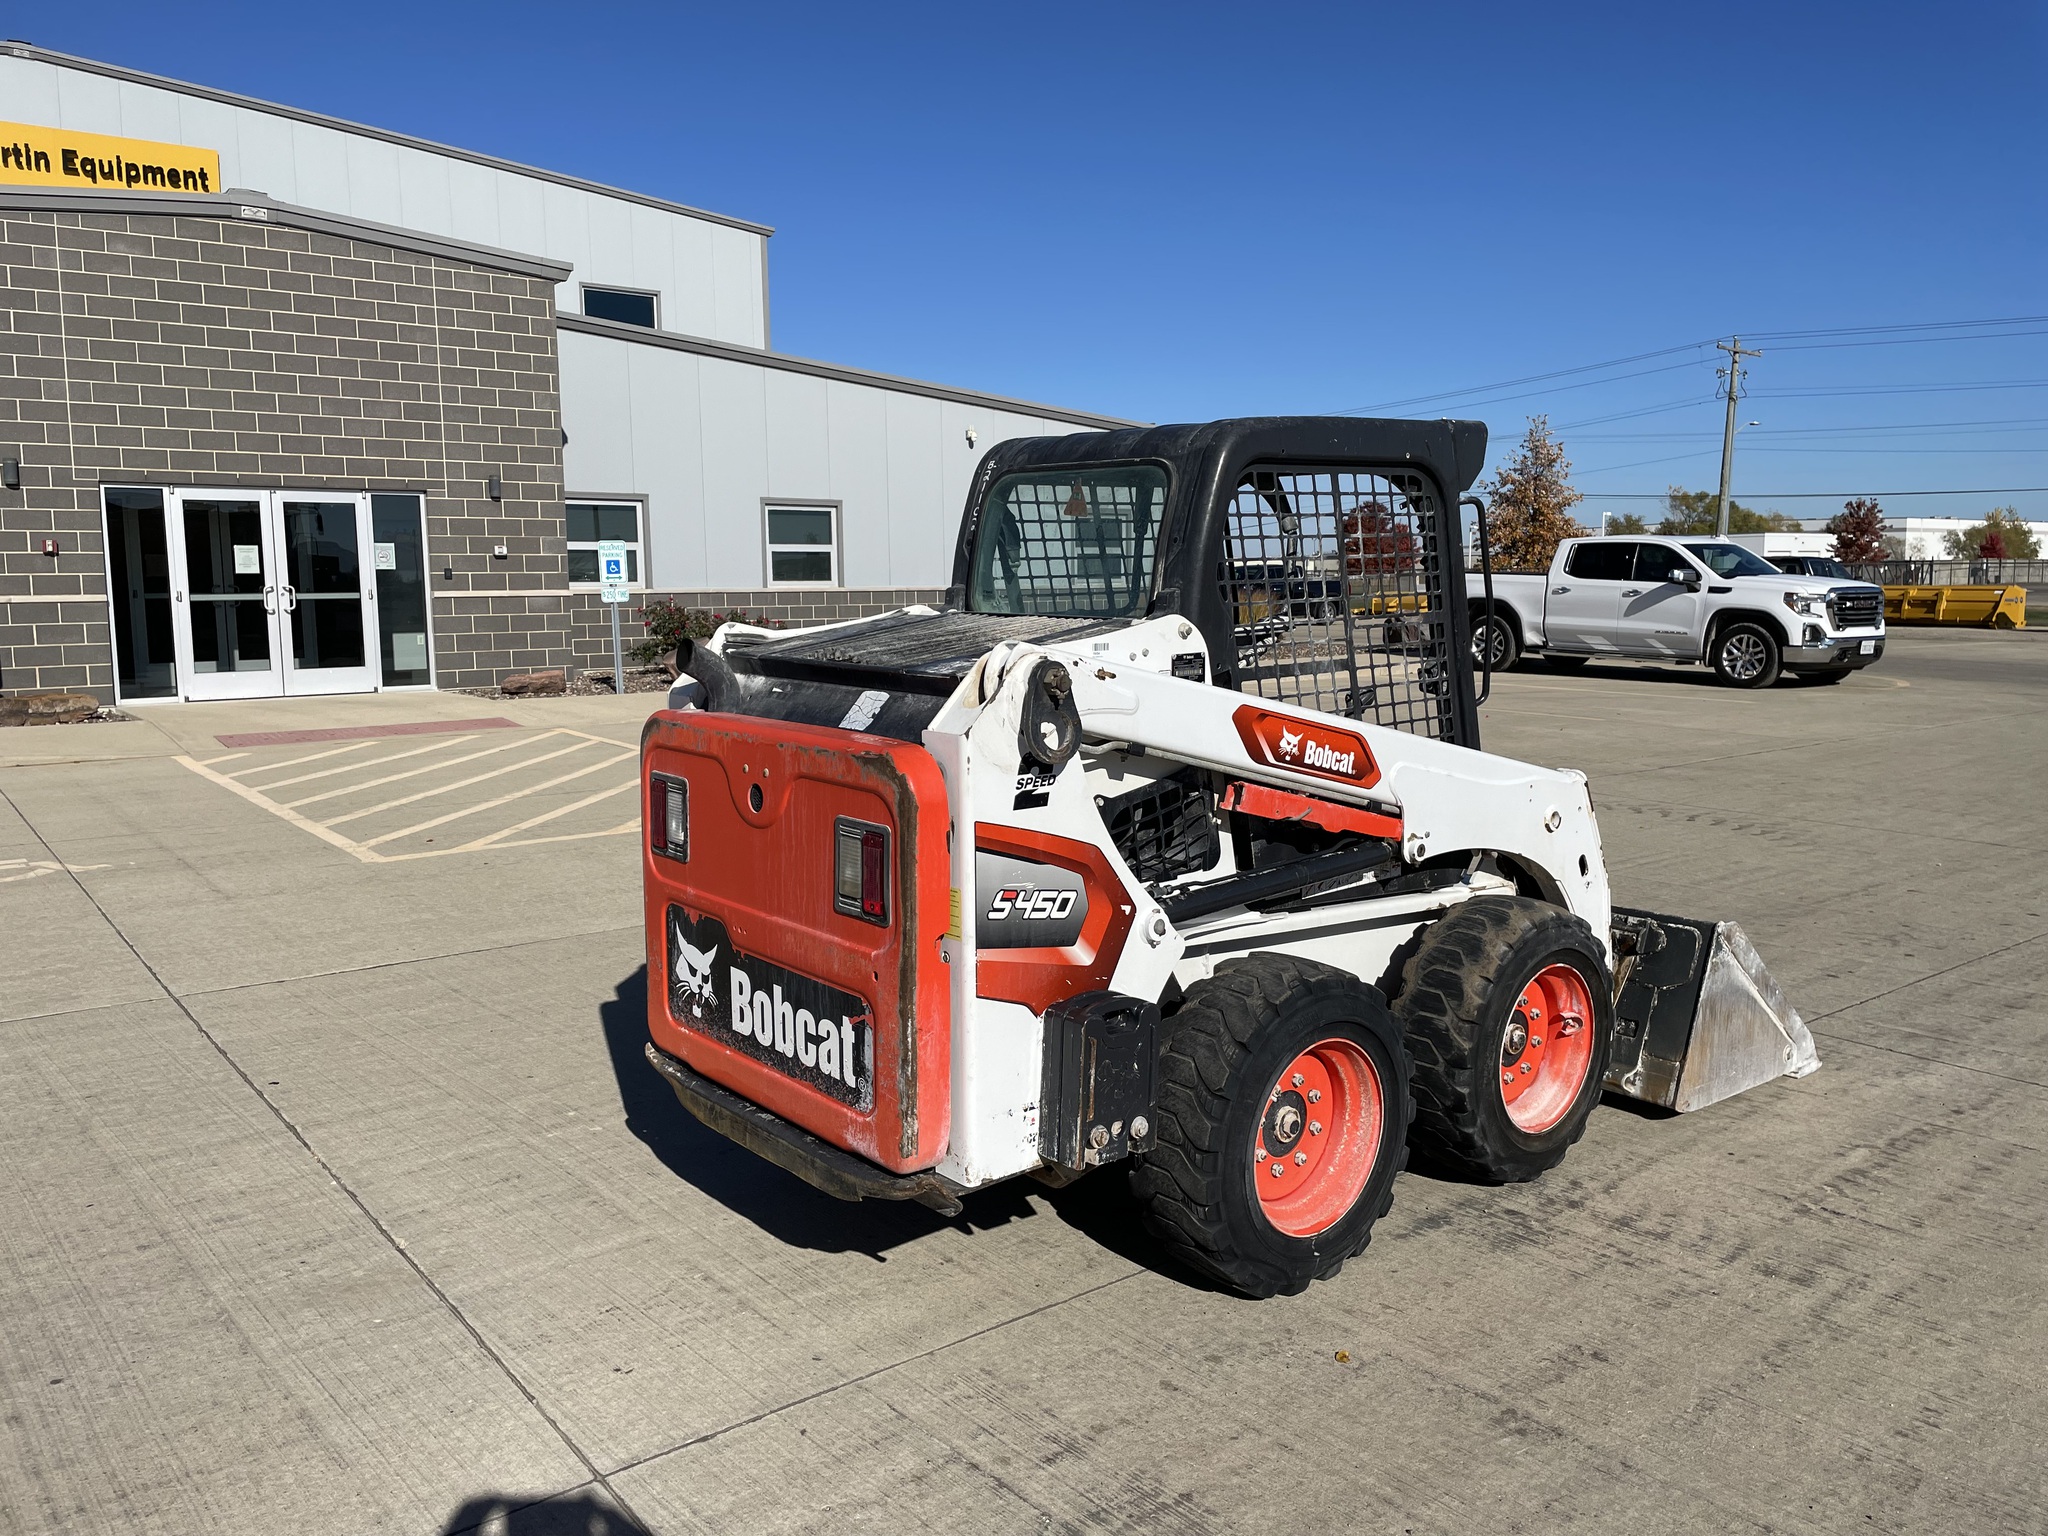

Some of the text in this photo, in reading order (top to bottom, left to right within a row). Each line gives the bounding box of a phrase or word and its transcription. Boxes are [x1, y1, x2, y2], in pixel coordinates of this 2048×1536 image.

[62, 149, 210, 193] Equipment
[1304, 740, 1355, 774] Bobcat
[1015, 775, 1057, 790] SPEED
[987, 888, 1078, 920] S450
[730, 966, 856, 1088] Bobcat
